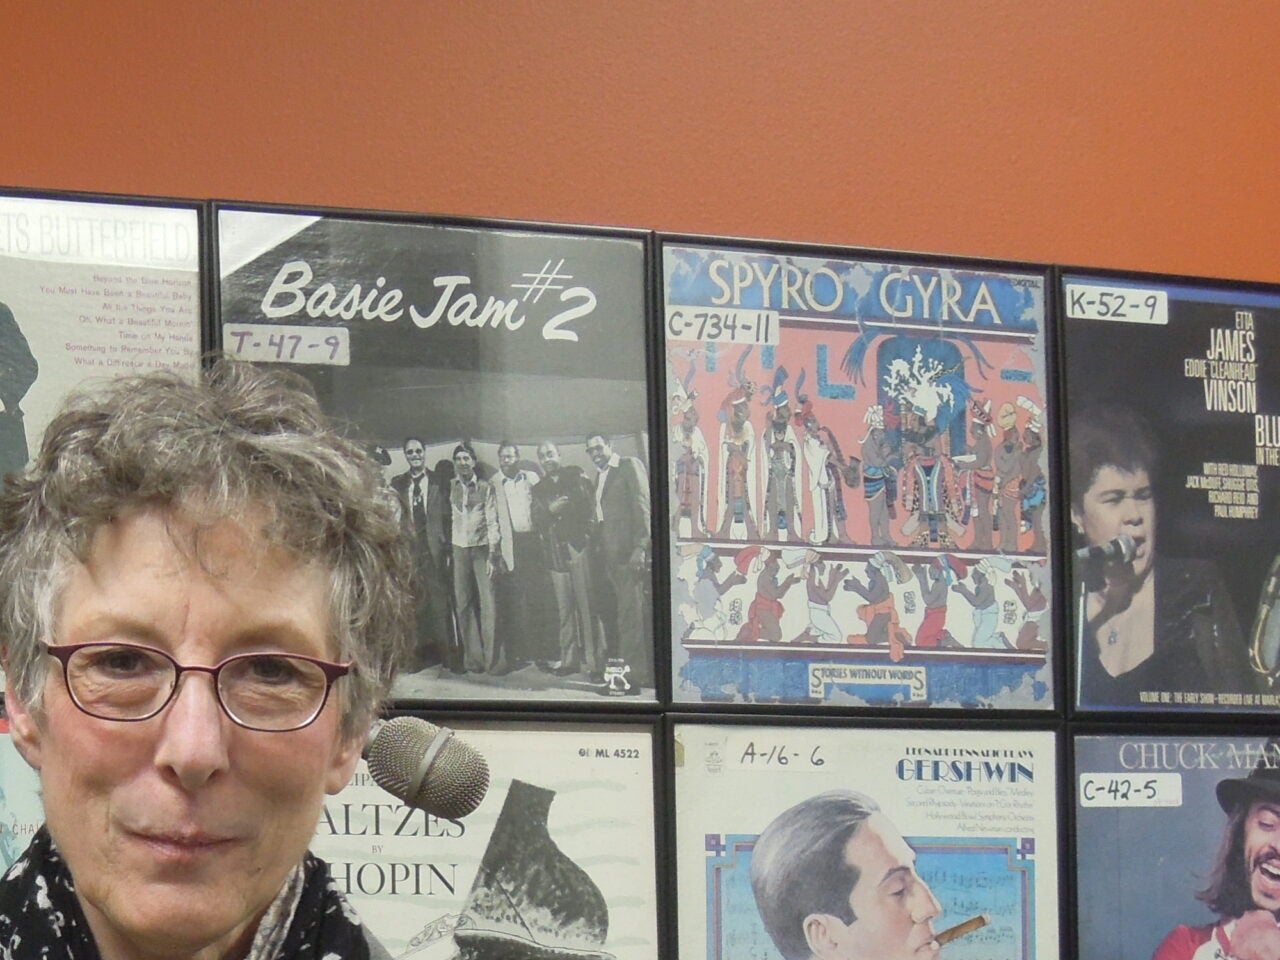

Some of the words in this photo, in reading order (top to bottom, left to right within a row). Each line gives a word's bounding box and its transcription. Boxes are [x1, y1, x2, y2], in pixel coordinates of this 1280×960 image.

[39, 215, 190, 263] BUTTERFIELD
[261, 261, 403, 321] Basie
[410, 275, 525, 330] Jam
[709, 261, 843, 312] SPYRO
[880, 273, 1001, 324] GYRA
[1071, 289, 1157, 320] K-52-9
[669, 311, 769, 343] C-734-11
[1235, 311, 1254, 330] ETTA
[230, 331, 340, 360] T-47-9
[1206, 328, 1255, 362] JAMES
[1184, 358, 1207, 378] EDDIE
[1204, 379, 1257, 413] VINSON
[595, 748, 610, 759] ML
[613, 748, 640, 759] 4522
[1120, 742, 1219, 770] CHUCK
[895, 758, 1034, 783] GERSHWIN
[1084, 779, 1157, 801] C-42-5
[316, 803, 466, 838] ALTZES
[371, 845, 384, 854] BY
[325, 862, 459, 896] HOPIN
